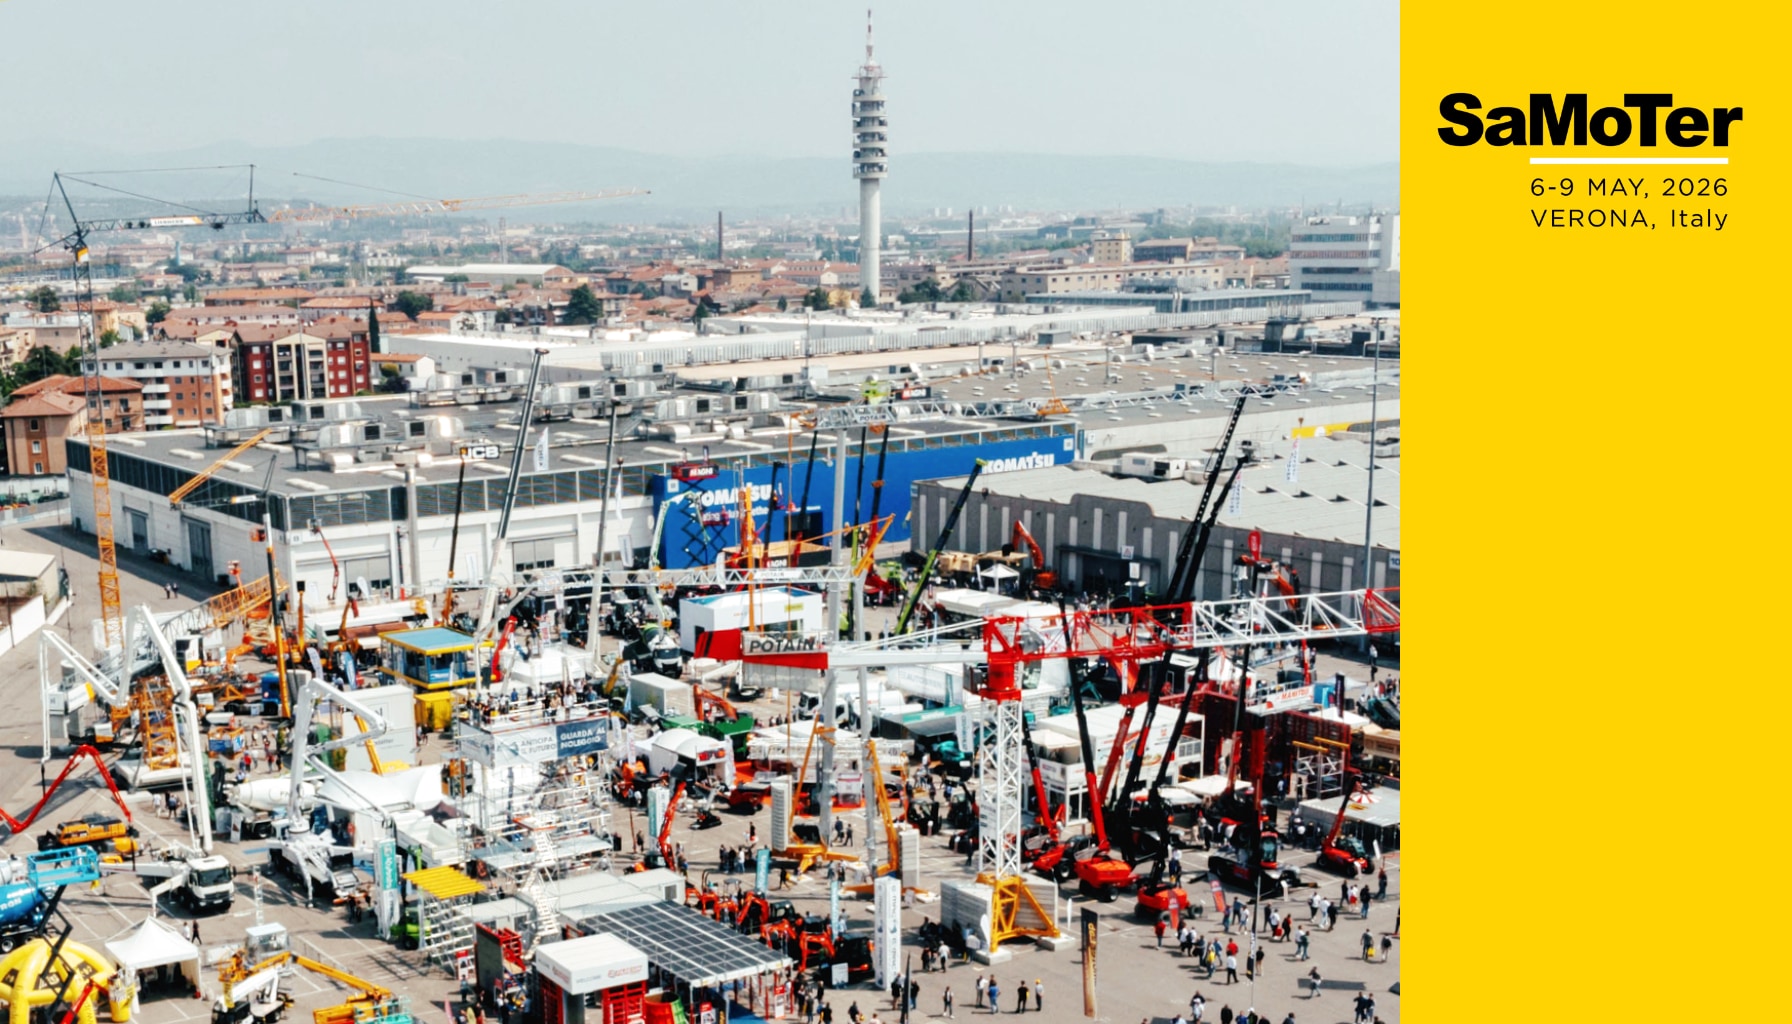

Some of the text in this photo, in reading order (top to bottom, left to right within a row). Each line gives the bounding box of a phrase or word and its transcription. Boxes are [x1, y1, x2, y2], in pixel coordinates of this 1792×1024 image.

[461, 445, 499, 459] JCB
[981, 451, 1055, 474] KOMATSU
[750, 638, 815, 653] POTAIN
[560, 726, 606, 741] GUARDA AL
[520, 736, 553, 747] ANTICIPA
[529, 742, 556, 755] FUTURO
[560, 735, 601, 750] NOLEGGIO
